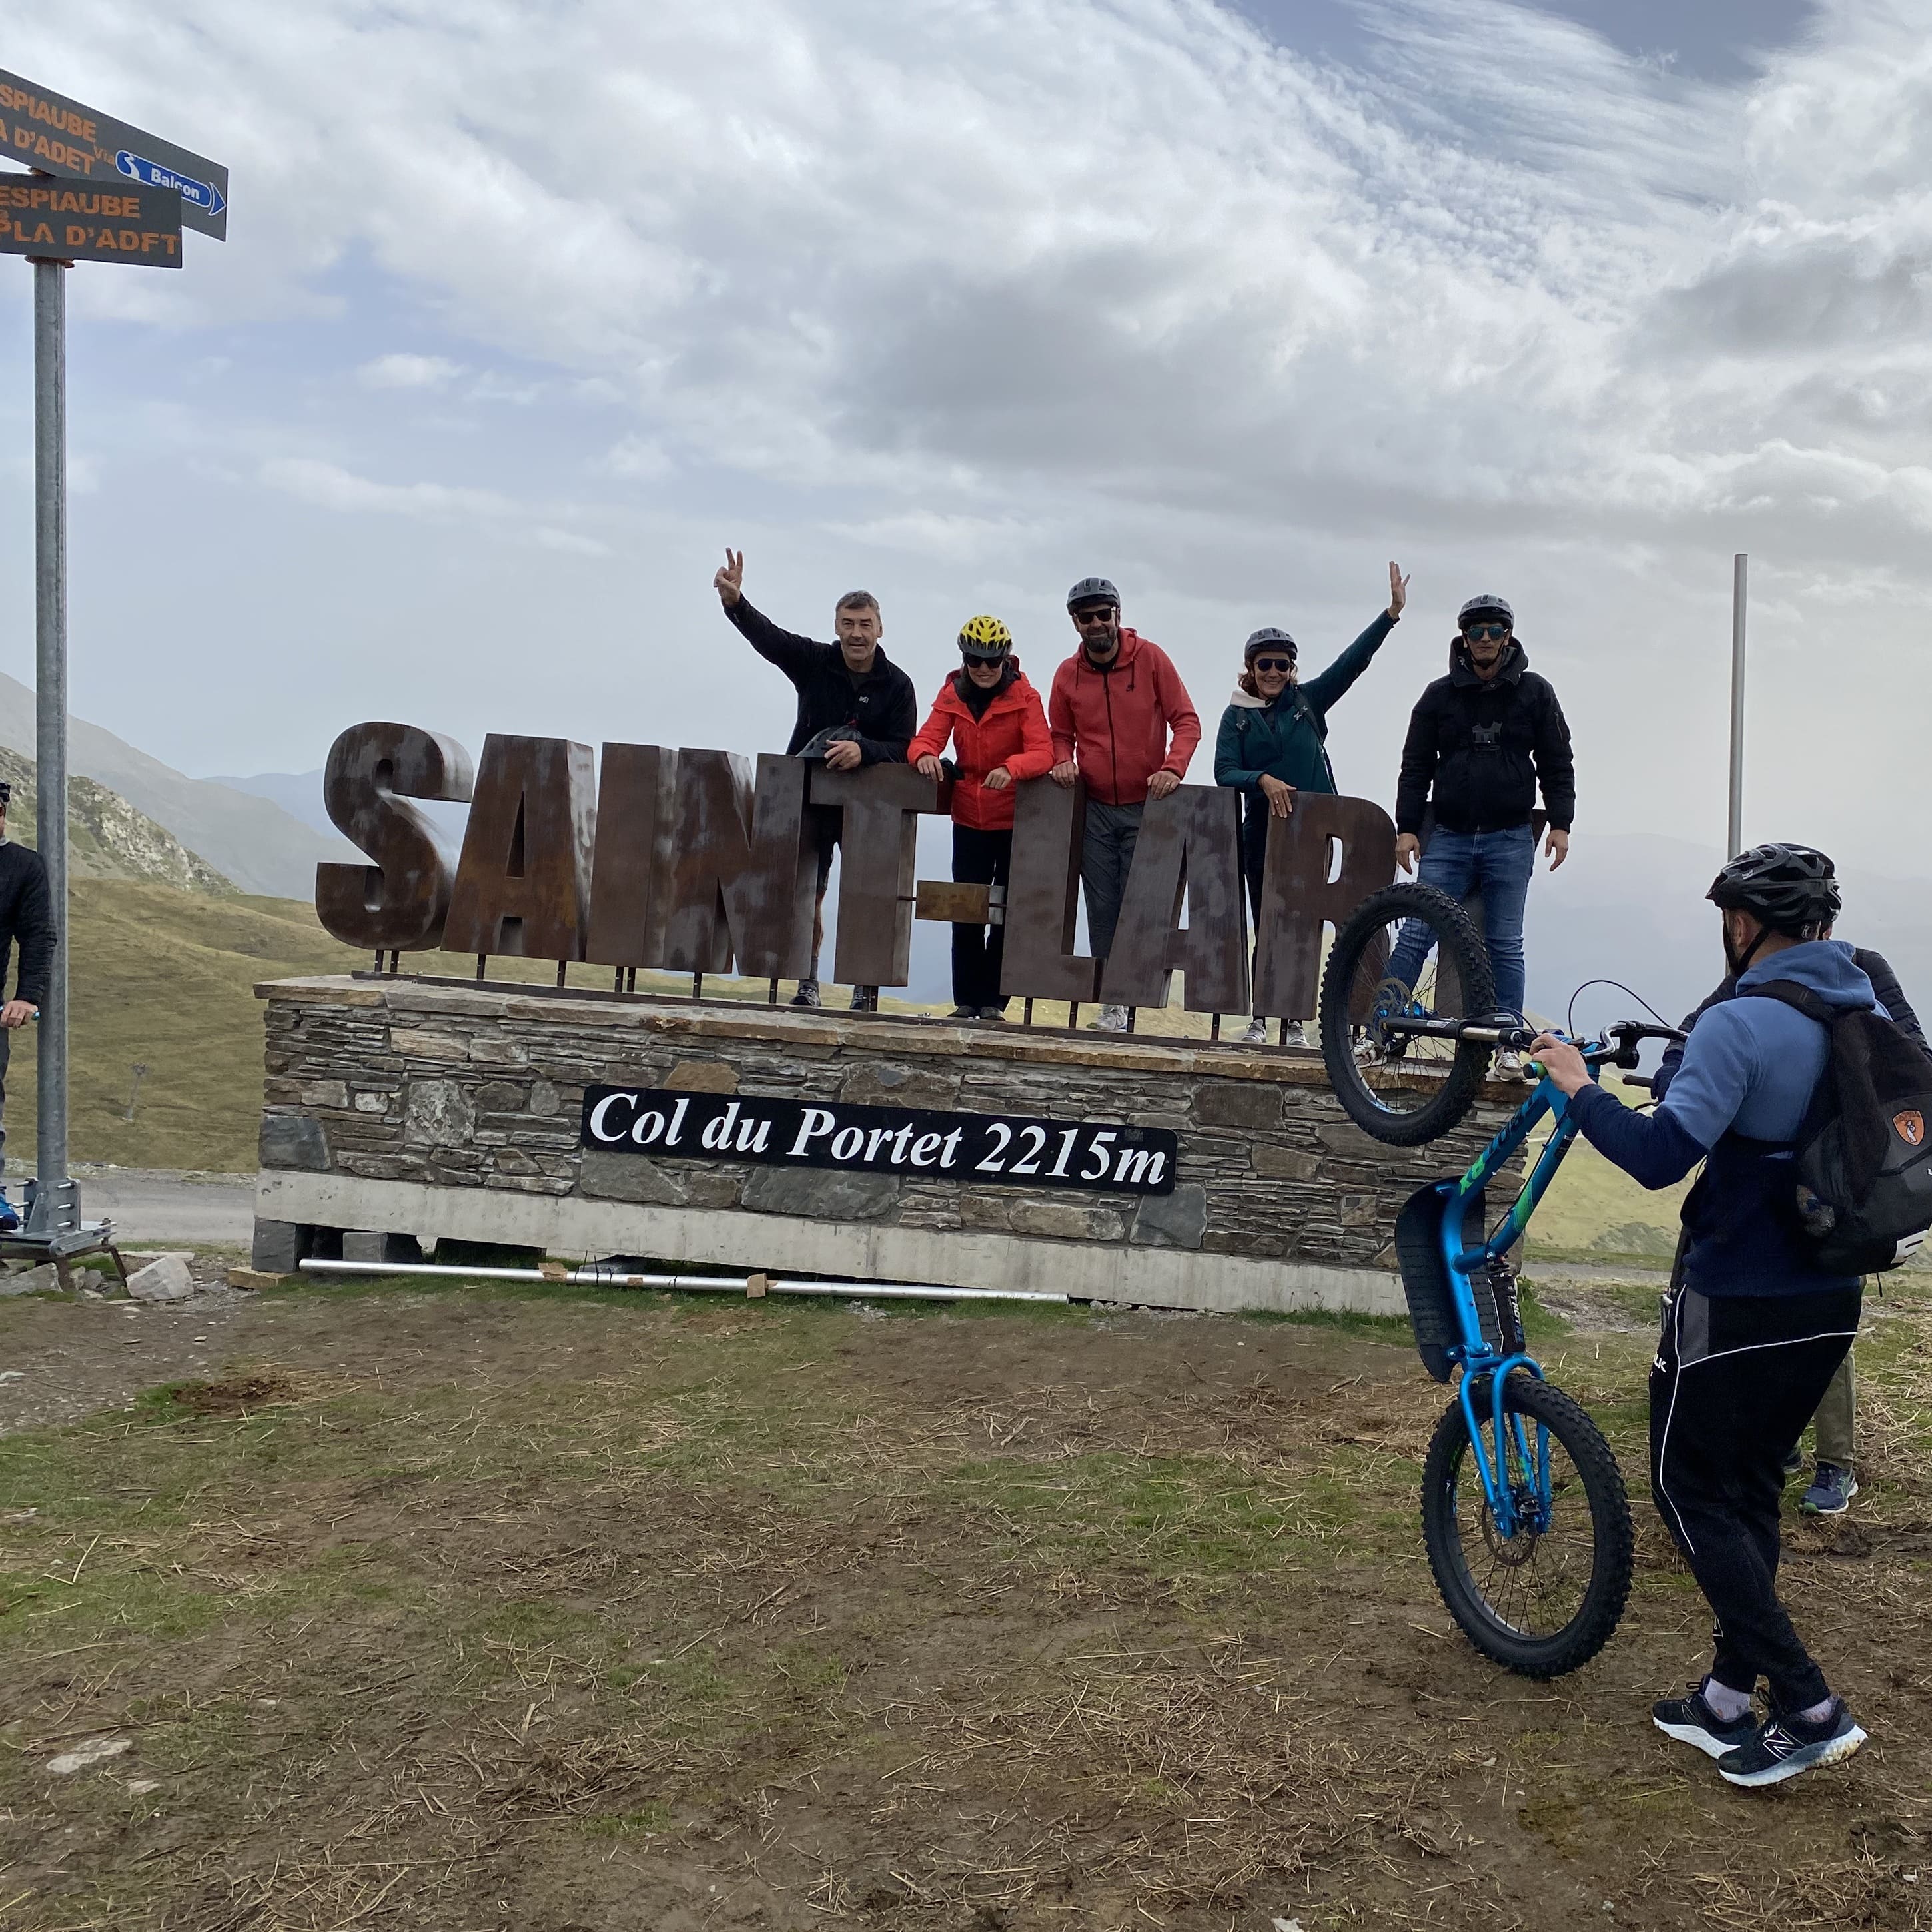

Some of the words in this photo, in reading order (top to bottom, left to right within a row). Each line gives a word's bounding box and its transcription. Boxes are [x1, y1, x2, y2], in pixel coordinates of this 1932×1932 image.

[0, 185, 141, 219] ESPIAUBE
[316, 721, 1548, 1026] SAINT-LAR
[590, 1093, 687, 1145] Col
[703, 1102, 769, 1153] du
[786, 1108, 963, 1167] Portet
[975, 1123, 1166, 1185] 2215m
